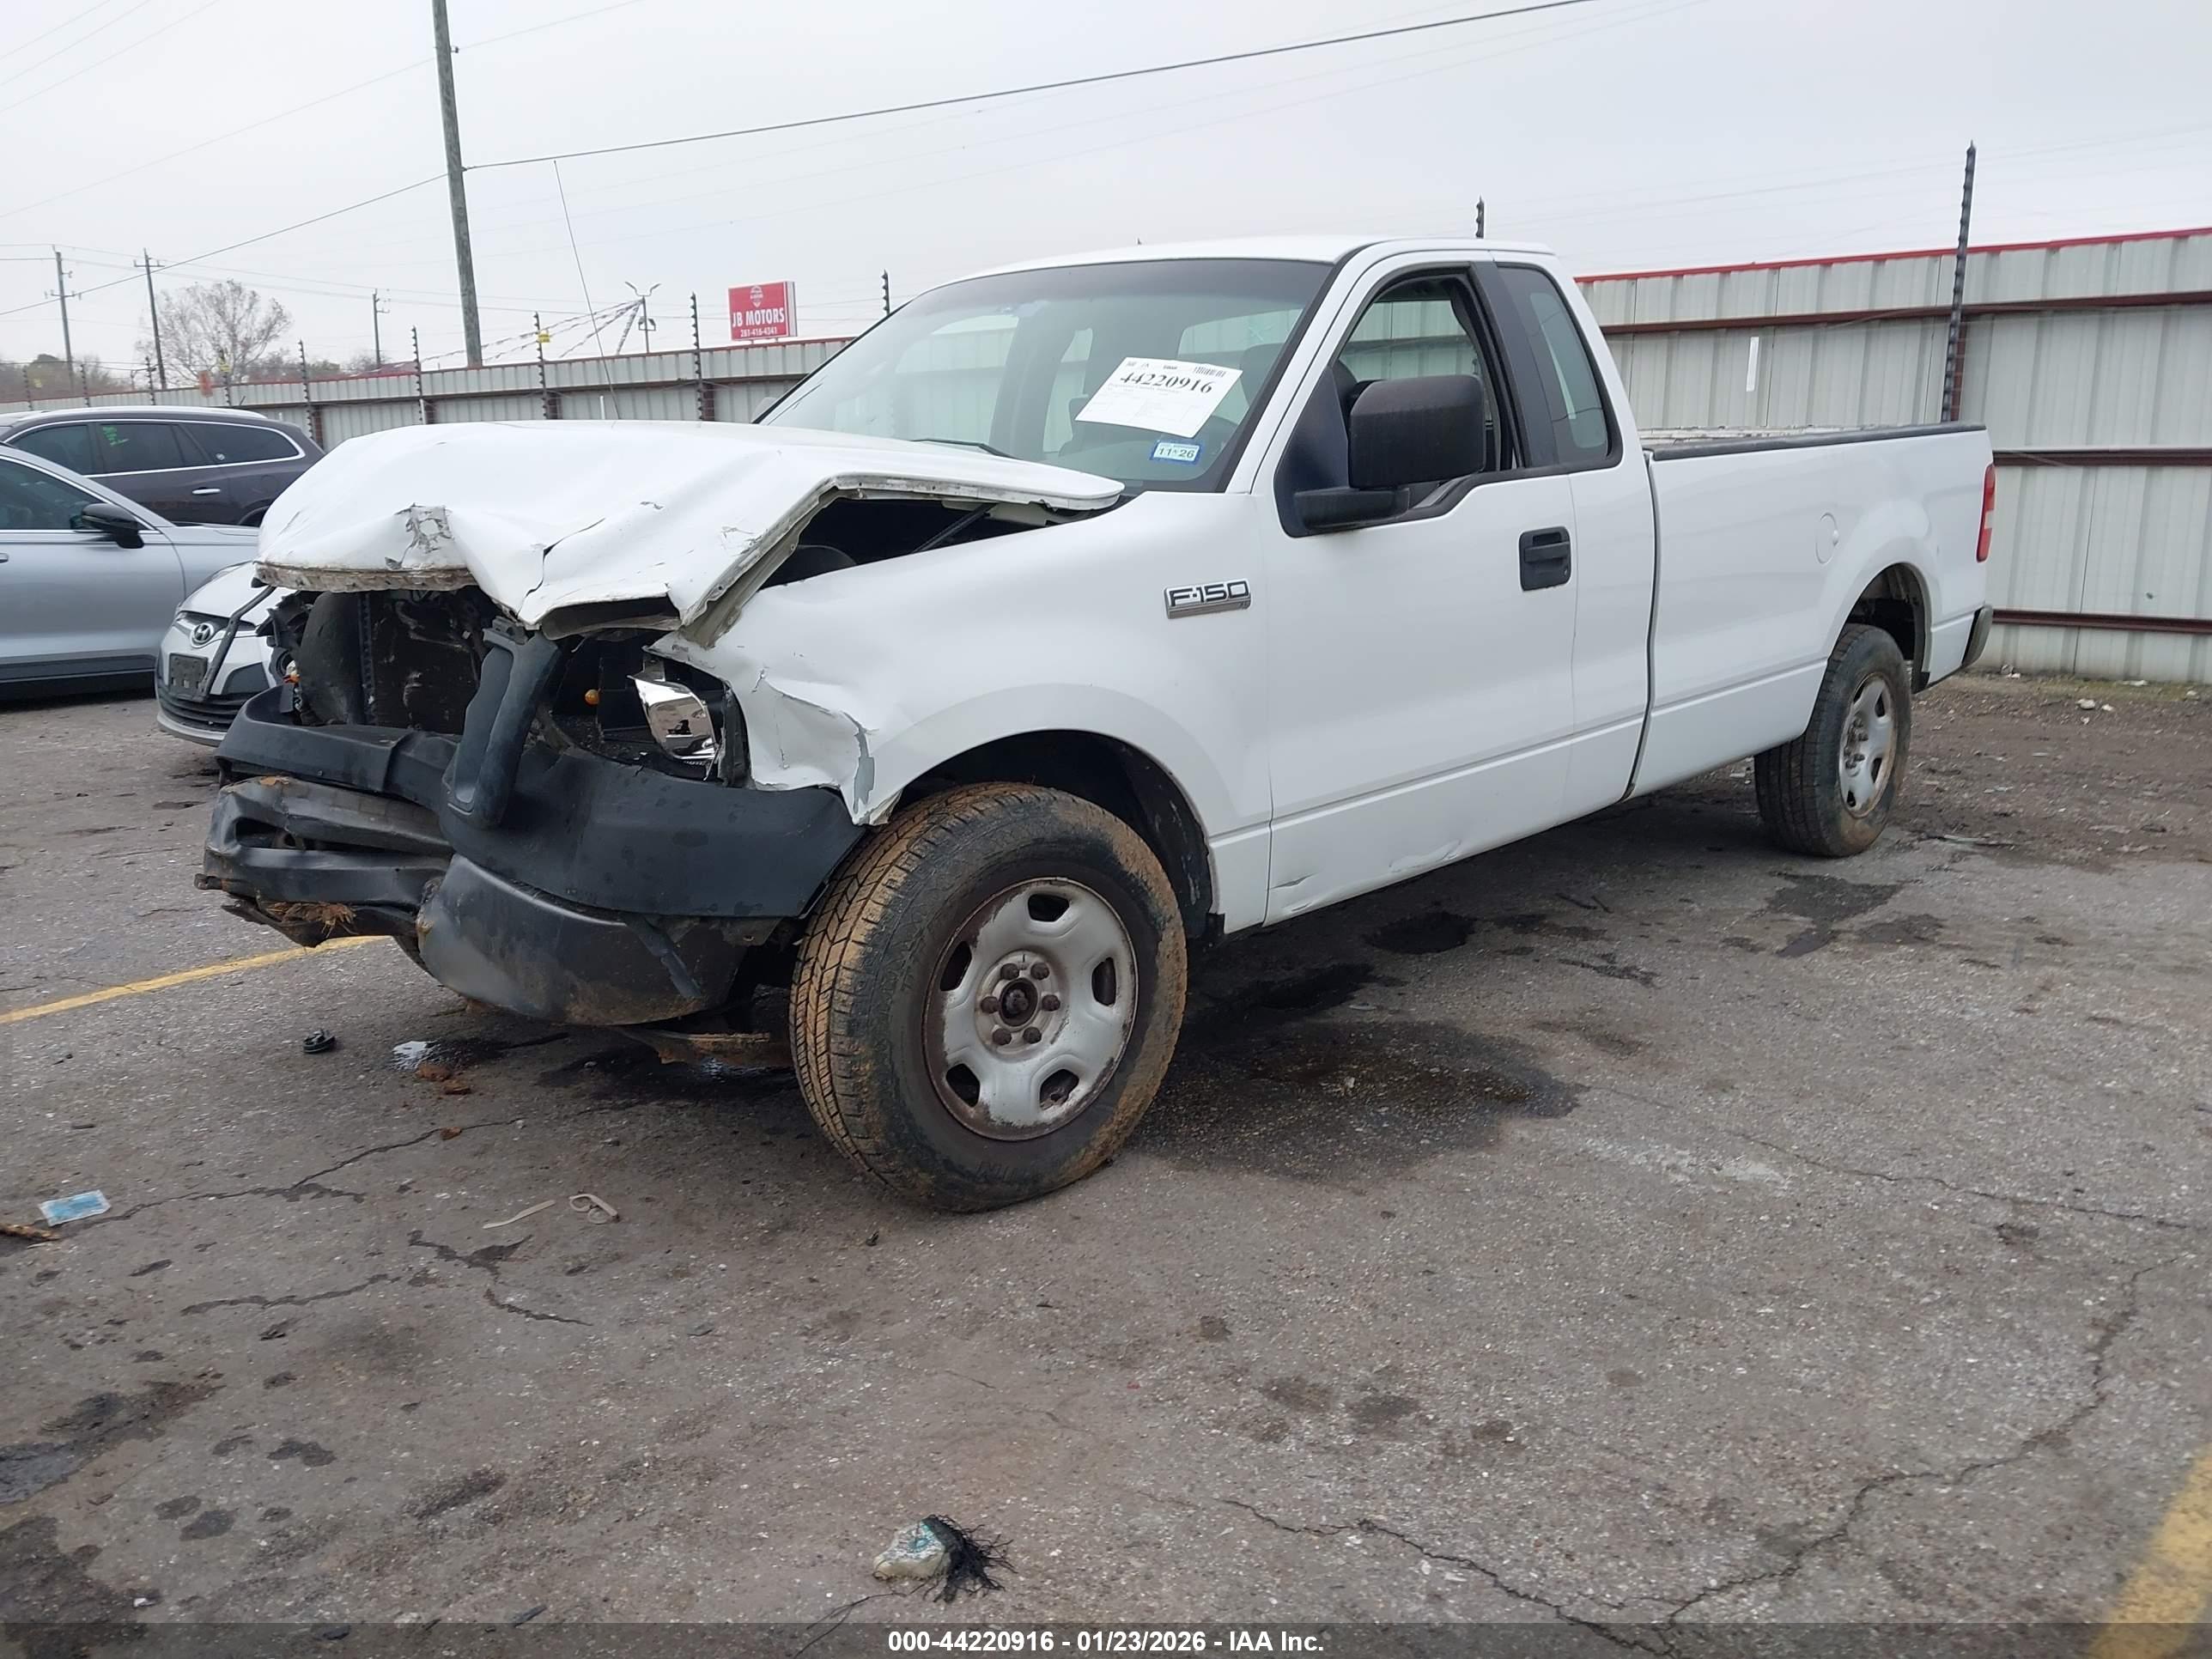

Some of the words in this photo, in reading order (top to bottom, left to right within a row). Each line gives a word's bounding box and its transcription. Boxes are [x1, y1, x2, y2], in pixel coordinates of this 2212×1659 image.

[732, 313, 743, 327] JB
[745, 307, 784, 325] MOTORS
[1120, 372, 1215, 393] 44220916
[1159, 447, 1172, 456] 11
[1178, 449, 1194, 459] 26
[1169, 580, 1249, 606] F-150
